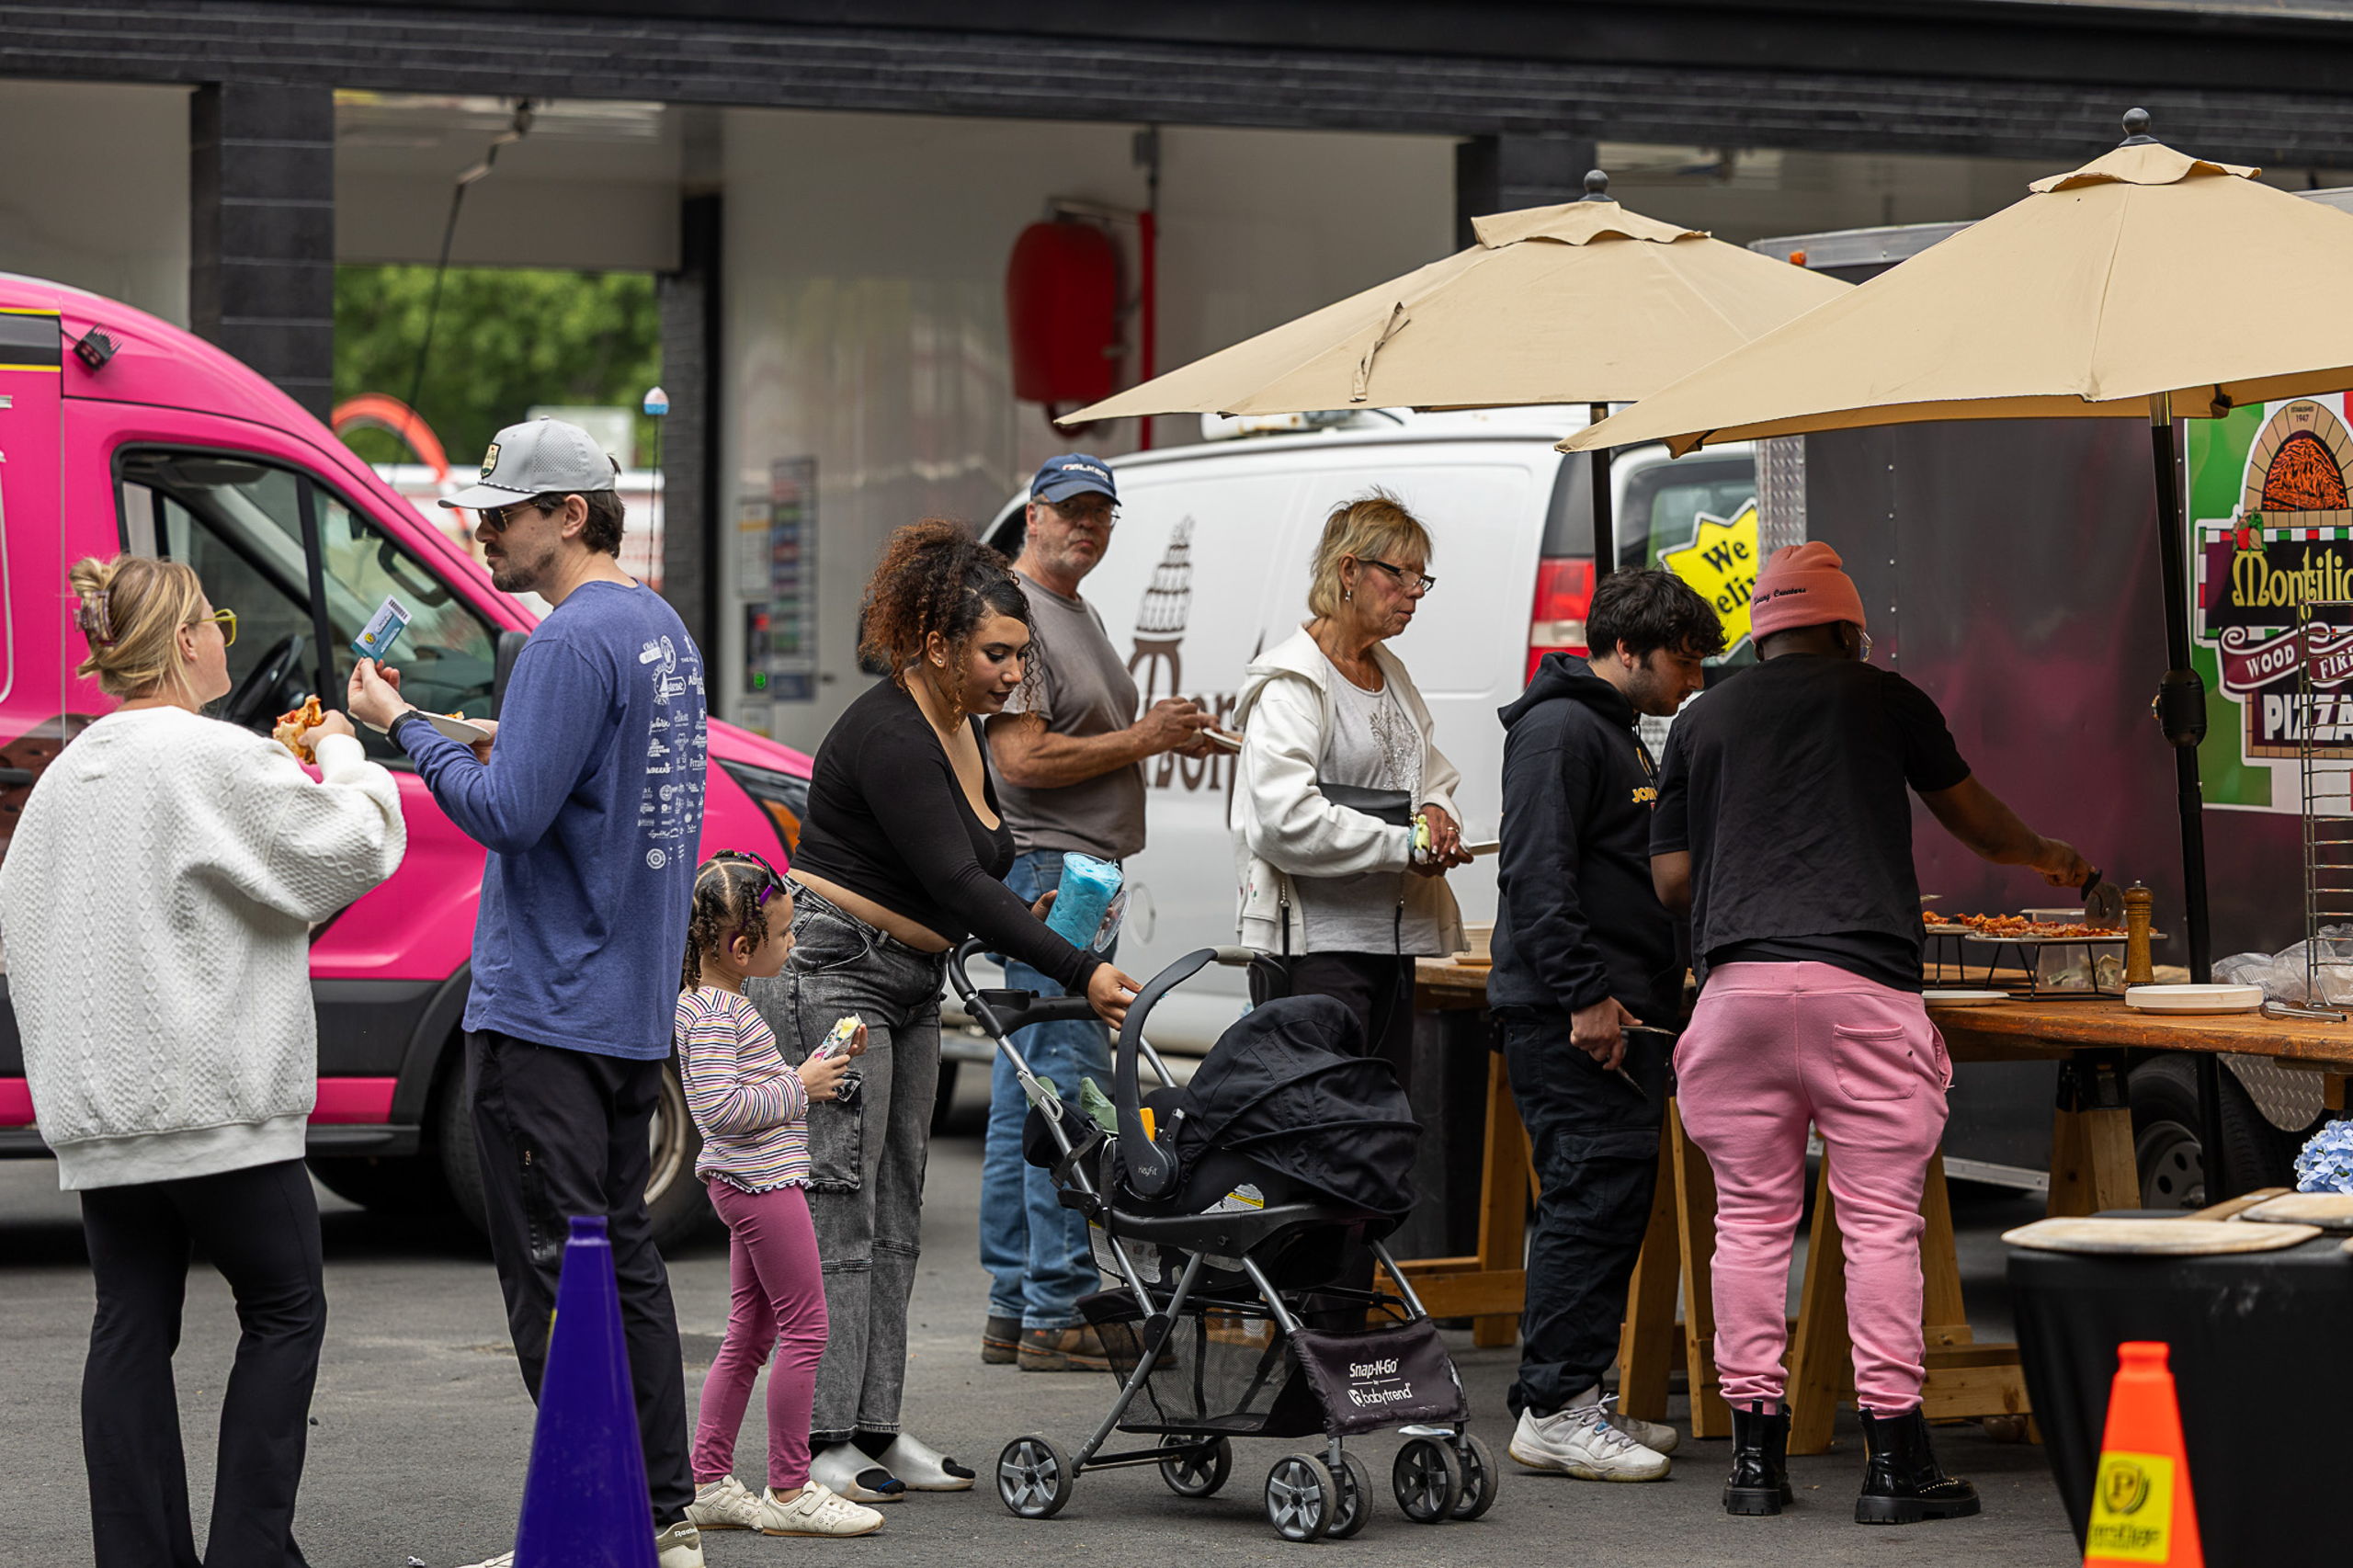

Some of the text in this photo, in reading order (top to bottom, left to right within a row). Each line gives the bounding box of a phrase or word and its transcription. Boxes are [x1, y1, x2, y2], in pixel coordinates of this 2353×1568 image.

[1701, 540, 1750, 574] We
[1716, 576, 1756, 614] eli
[2245, 644, 2295, 678] WOOD
[2263, 694, 2353, 741] PIZZA
